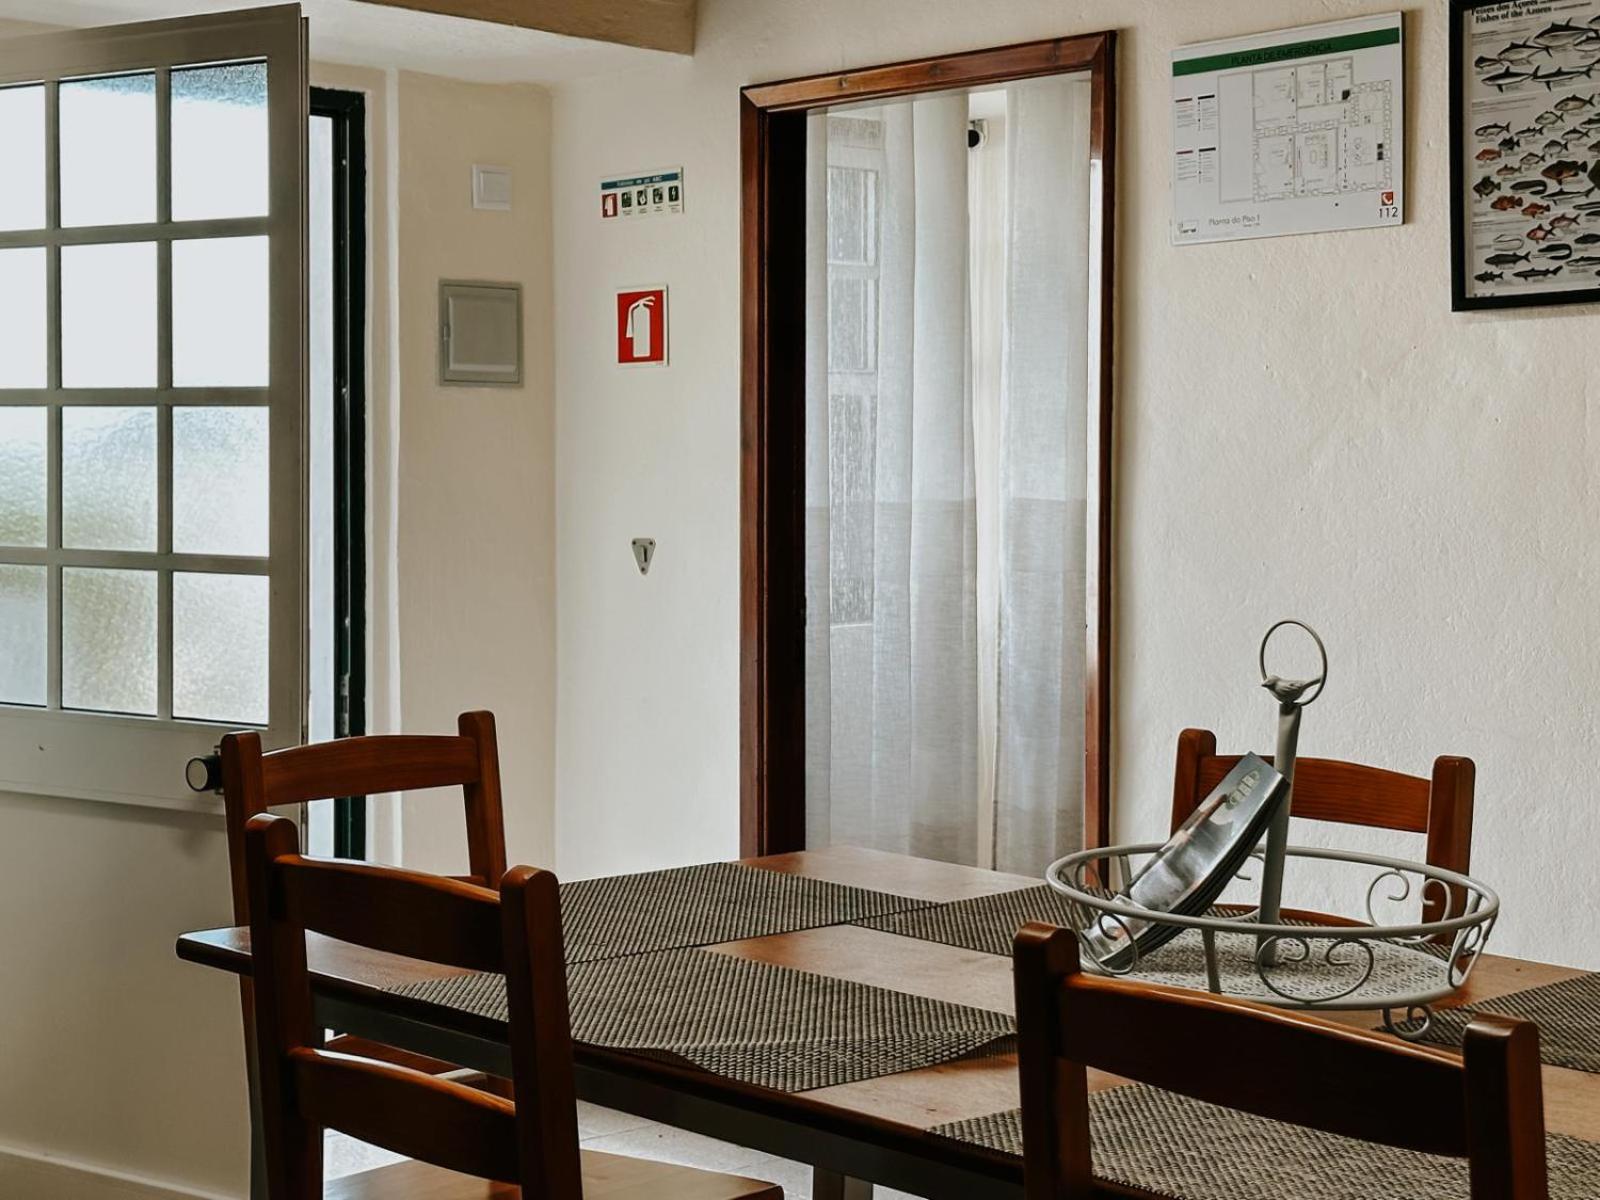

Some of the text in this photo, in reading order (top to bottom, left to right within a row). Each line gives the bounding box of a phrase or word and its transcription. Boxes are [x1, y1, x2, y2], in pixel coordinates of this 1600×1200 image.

[1476, 15, 1500, 23] Fishes
[1526, 6, 1552, 15] Azores
[1231, 52, 1262, 64] PLANTA
[1379, 206, 1398, 218] 112
